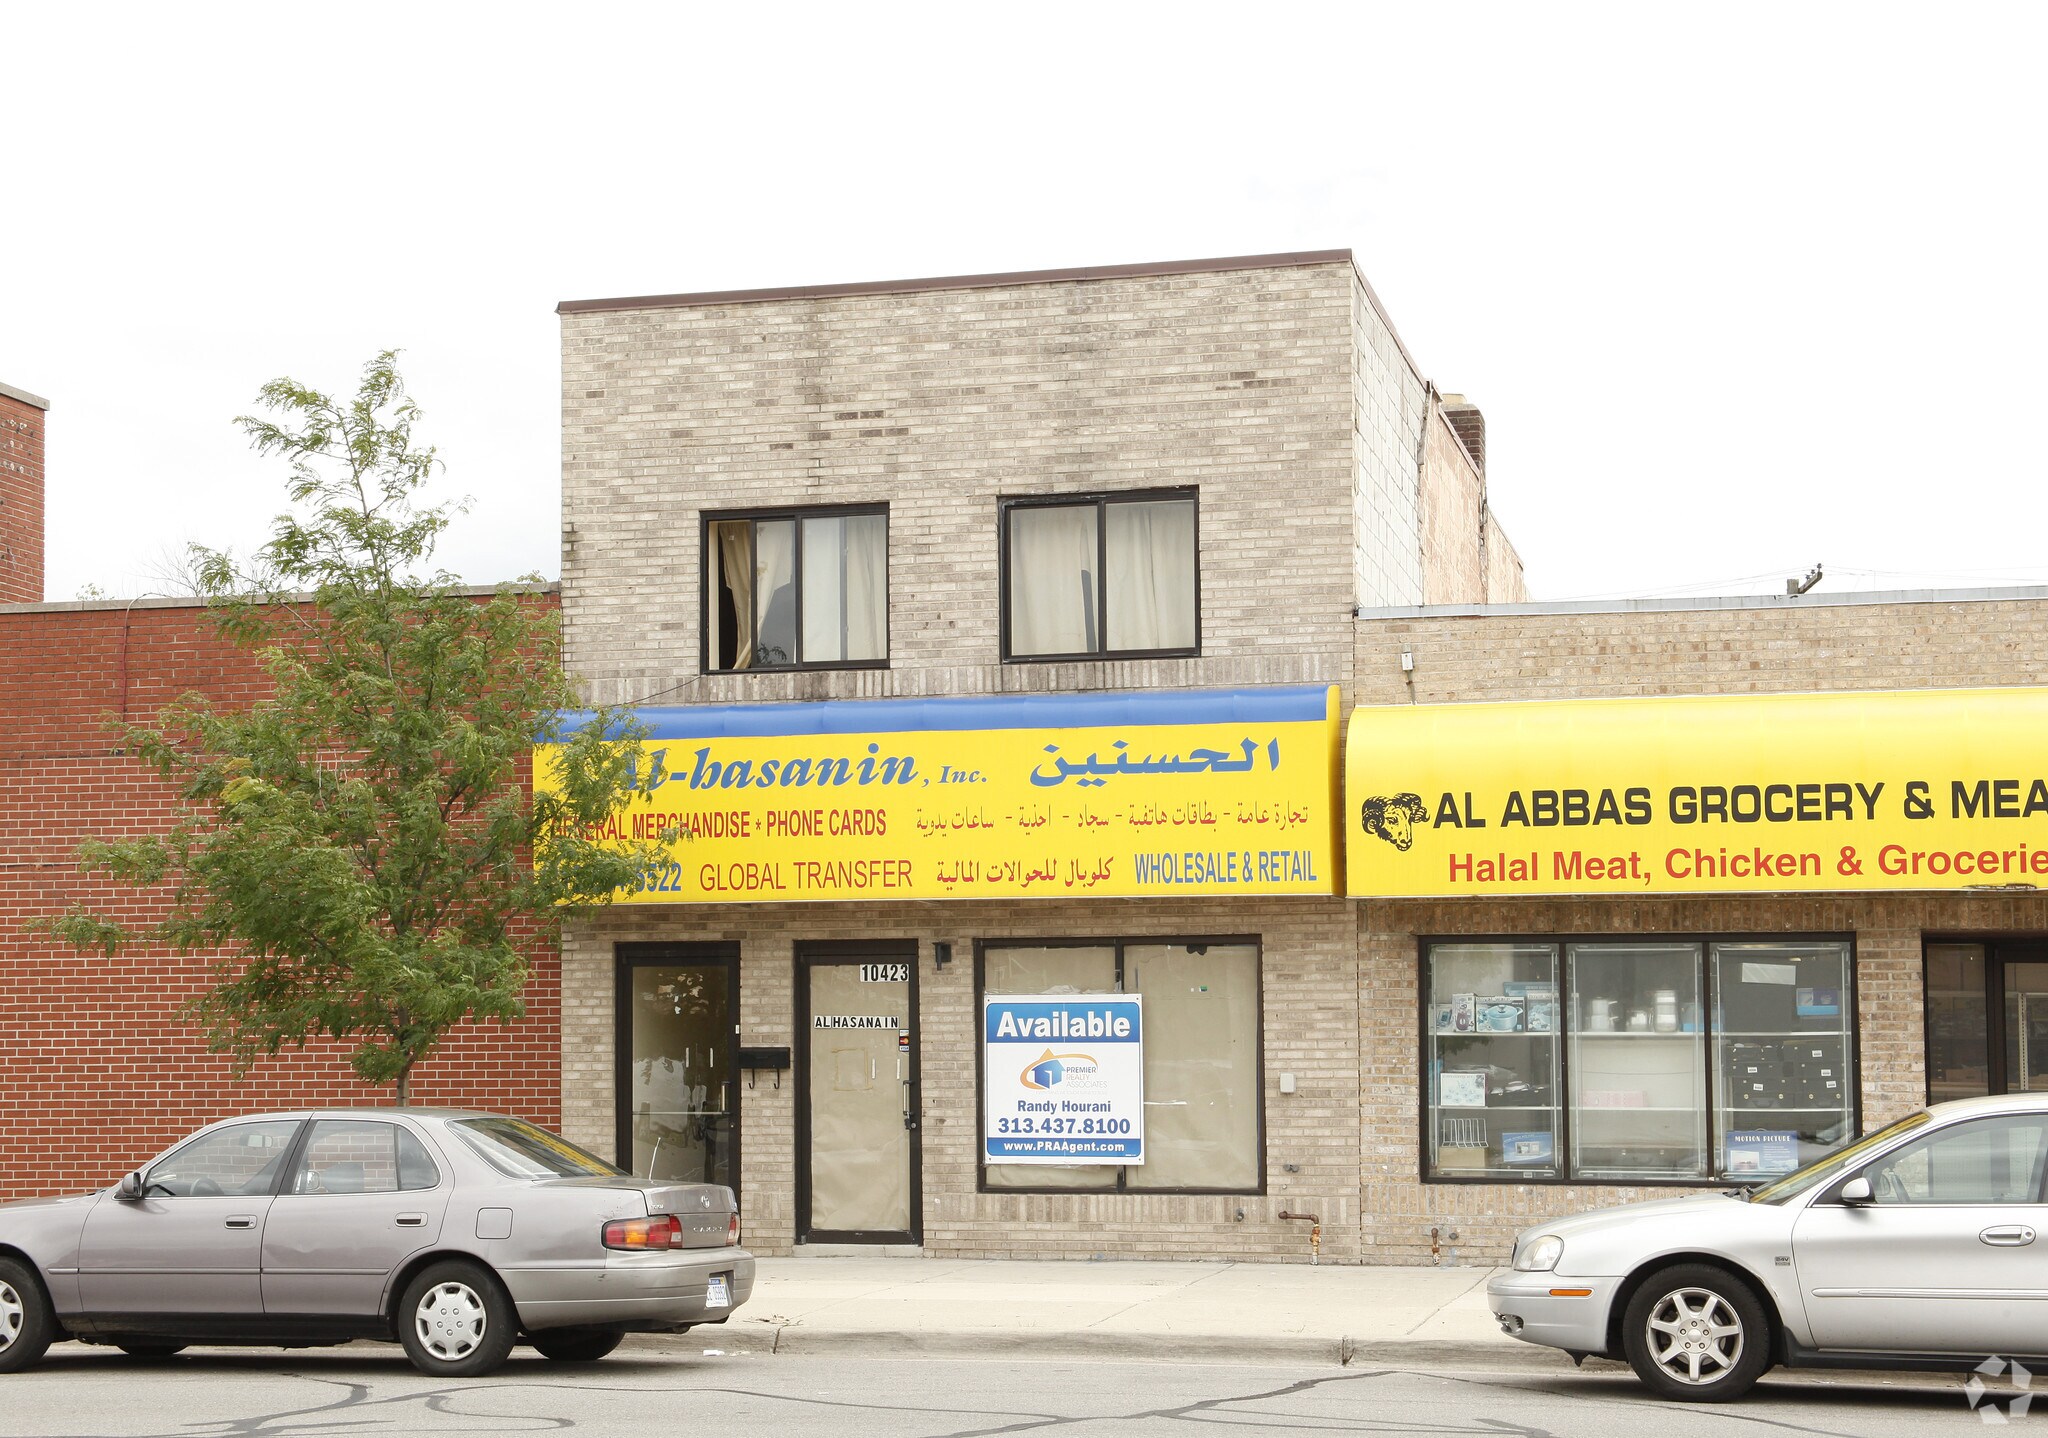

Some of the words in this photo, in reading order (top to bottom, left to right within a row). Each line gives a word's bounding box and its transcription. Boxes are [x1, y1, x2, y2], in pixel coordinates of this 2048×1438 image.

[937, 765, 988, 784] Inc.
[1029, 736, 1280, 787] الحسنين
[951, 805, 995, 830] ساعات
[1077, 803, 1110, 834] سجاد
[1172, 800, 1218, 833] بطاقات
[1236, 800, 1270, 824] عامة
[1274, 800, 1309, 831] تجارة
[1433, 791, 1486, 829] AL
[1500, 786, 1652, 828] ABBAS
[1668, 782, 1885, 825] GROCERY
[1904, 781, 1935, 820] &
[1951, 779, 2048, 819] MEA
[632, 810, 750, 841] MERCHANDISE
[766, 809, 824, 837] PHONE
[829, 808, 887, 836] CARDS
[916, 807, 947, 838] يدوية
[700, 861, 786, 891] GLOBAL
[793, 859, 913, 889] TRANSFER
[936, 859, 980, 891] المالية
[986, 857, 1057, 888] للحوالات
[1134, 851, 1237, 884] WHOLESALE
[1242, 851, 1254, 882] &
[1258, 850, 1317, 882] RETAIL
[1449, 852, 1538, 882] Halal
[1553, 850, 1651, 886] Meat,
[1665, 847, 1822, 879] Chicken
[1836, 845, 1864, 876] &
[1878, 843, 2048, 876] Grocerie
[862, 965, 908, 981] 10423
[996, 1010, 1131, 1038] Available
[1066, 1081, 1108, 1089] ASSOCIATES
[1017, 1100, 1058, 1115] Randy
[1062, 1100, 1111, 1112] Hourani
[998, 1117, 1131, 1134] 313.437.8100
[1003, 1141, 1125, 1153] www.PRAAgent.com
